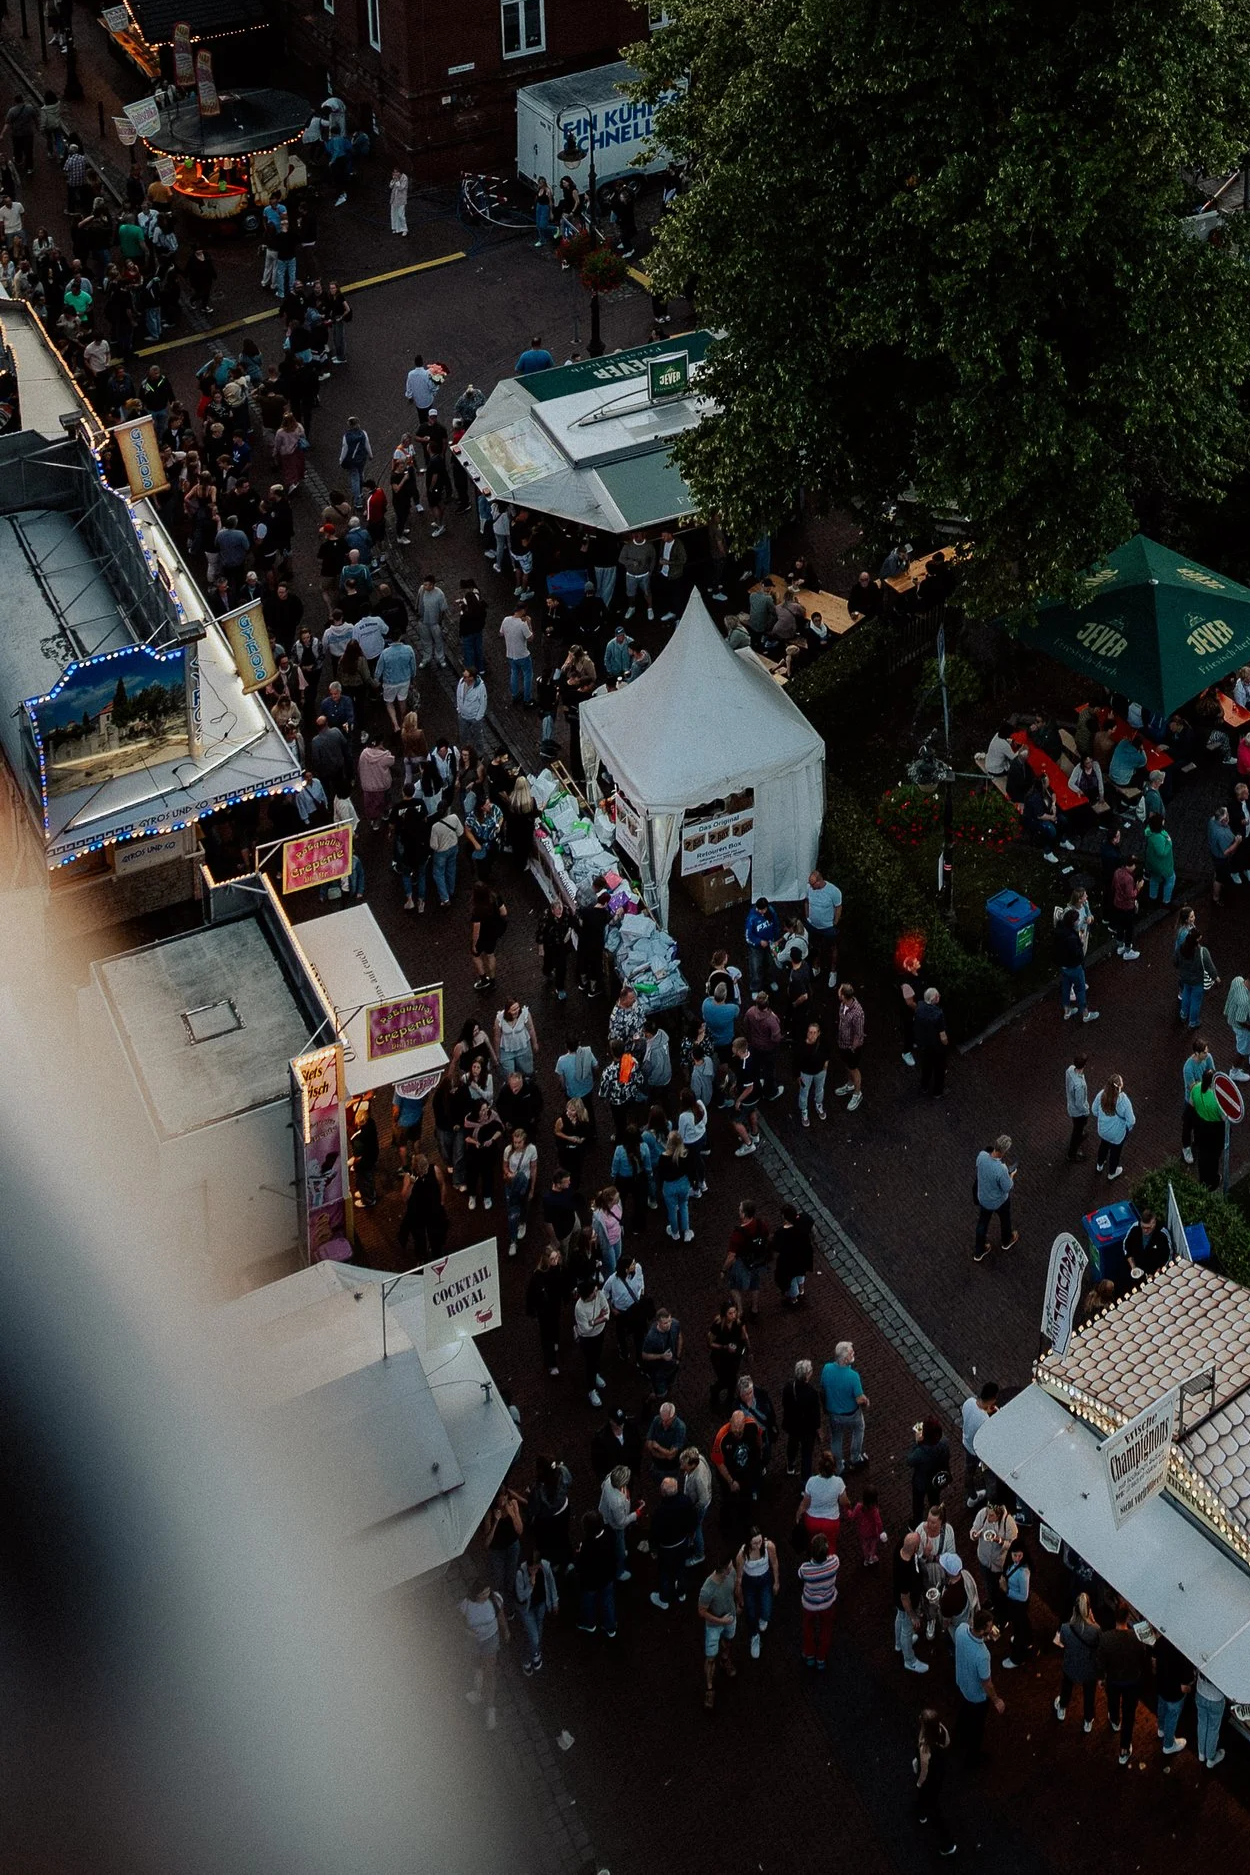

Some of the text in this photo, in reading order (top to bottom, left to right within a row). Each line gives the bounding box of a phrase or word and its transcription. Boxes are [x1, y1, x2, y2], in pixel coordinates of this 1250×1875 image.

[659, 371, 682, 386] JEVER
[129, 428, 154, 490] GYROS
[238, 614, 267, 681] GYROS
[1076, 622, 1128, 658] JEVER
[1187, 619, 1234, 656] JEVER
[1053, 637, 1119, 677] Friesisch-herb.
[139, 813, 170, 828] GYROS
[172, 807, 193, 819] UND
[713, 815, 740, 827] Original
[121, 849, 146, 863] GYROS
[147, 844, 163, 855] UND
[696, 847, 728, 869] Retouren
[728, 841, 742, 852] Box
[301, 1066, 322, 1082] Stets
[307, 1081, 328, 1099] risch
[432, 1265, 491, 1306] COCKTAIL
[446, 1288, 486, 1318] ROYAL
[1124, 1413, 1158, 1444] Frische
[1110, 1416, 1170, 1483] Champignons
